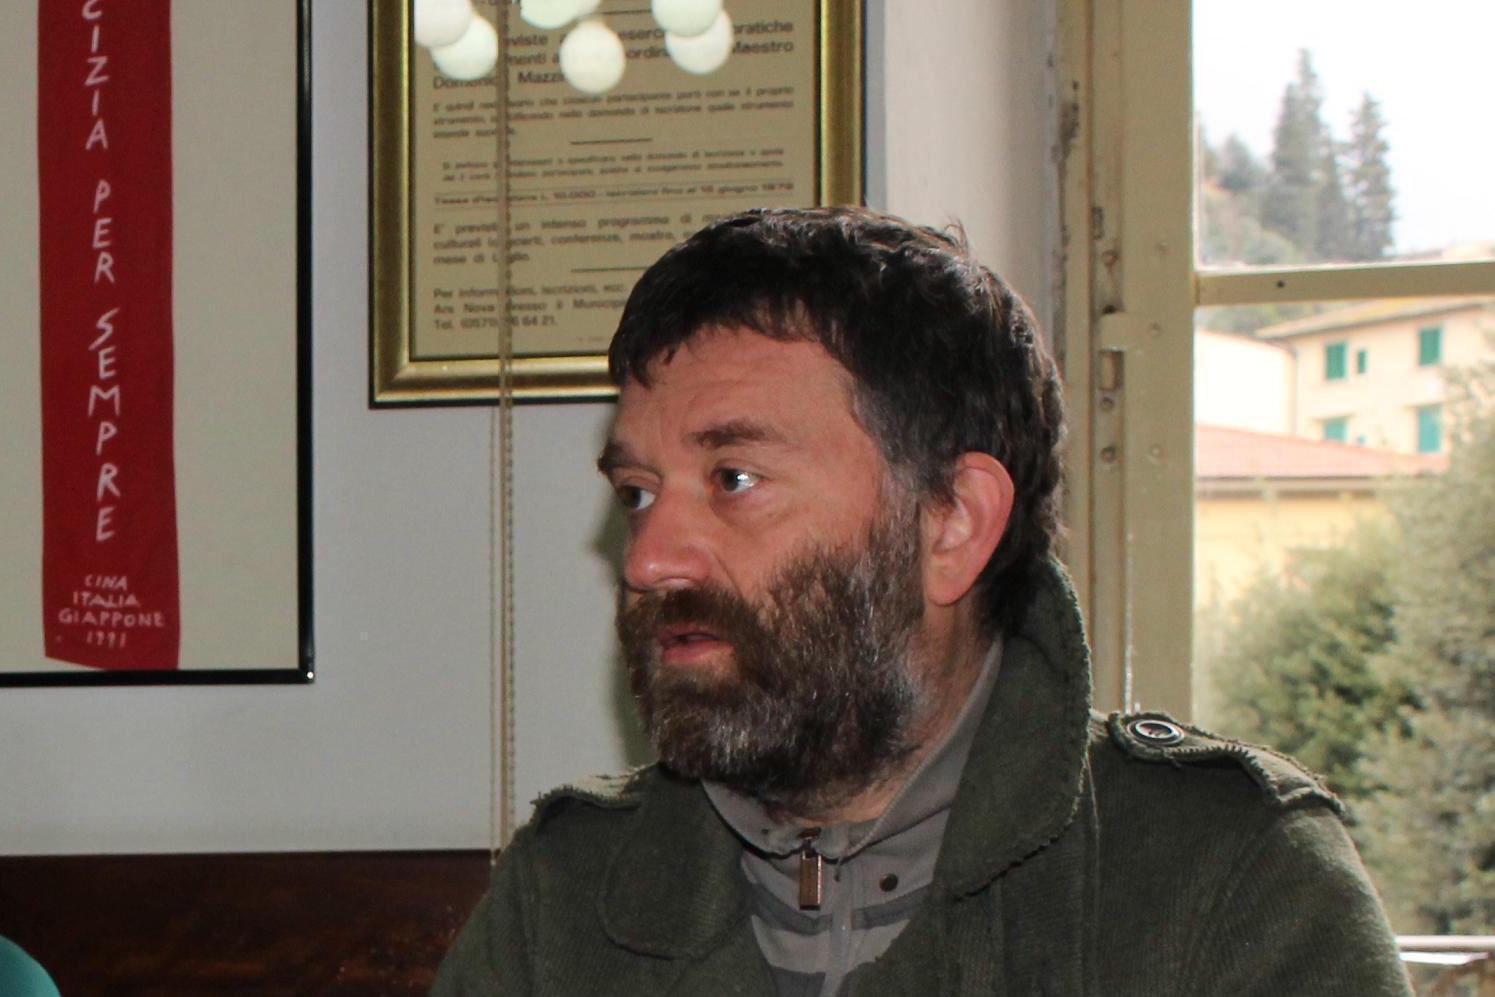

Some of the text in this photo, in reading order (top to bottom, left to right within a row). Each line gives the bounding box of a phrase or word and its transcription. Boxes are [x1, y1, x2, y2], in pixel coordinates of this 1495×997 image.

[92, 179, 115, 283] PER
[88, 307, 121, 543] SEMPRE
[84, 574, 128, 591] CINA
[72, 591, 141, 609] ITALIA
[58, 608, 164, 628] GIAPPONE
